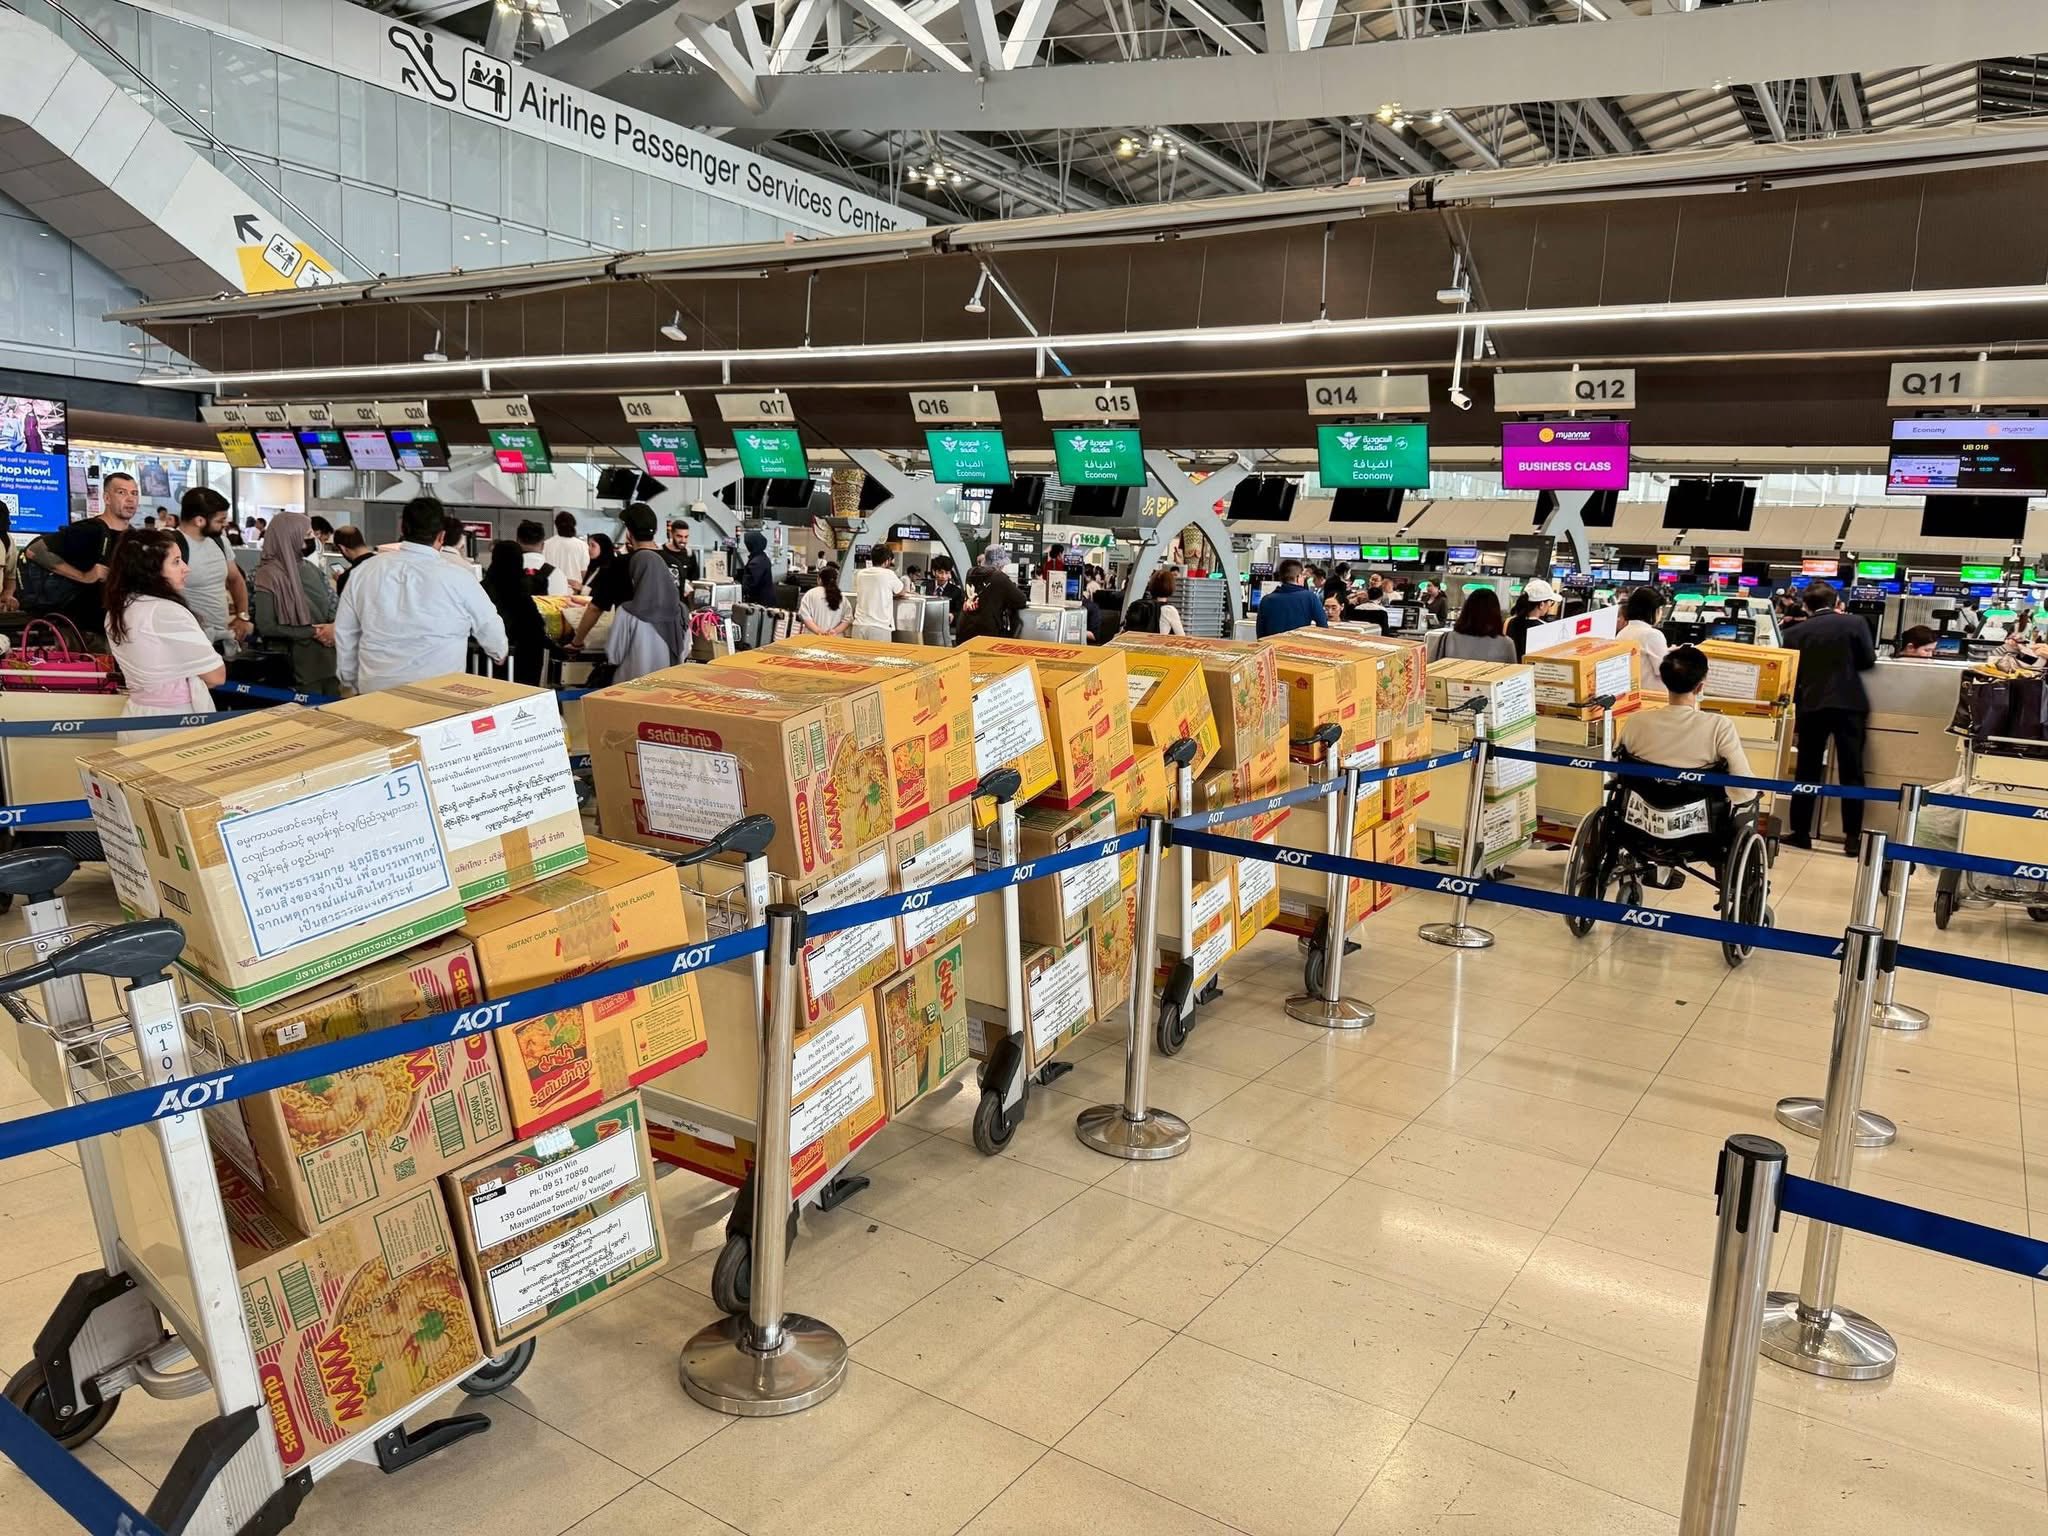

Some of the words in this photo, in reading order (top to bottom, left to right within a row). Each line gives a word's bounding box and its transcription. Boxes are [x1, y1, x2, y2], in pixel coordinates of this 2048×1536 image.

[520, 82, 605, 140] Airline
[616, 115, 739, 185] Passenger
[747, 163, 832, 218] Services
[839, 197, 896, 233] Center
[1575, 380, 1625, 401] Q12
[1903, 372, 1961, 395] Q11
[1095, 396, 1129, 412] Q15
[1315, 388, 1357, 405] Q14
[358, 409, 375, 419] Q21
[405, 408, 424, 419] Q20
[506, 404, 528, 417] Q19
[627, 403, 651, 416] Q18
[760, 401, 785, 414] Q17
[918, 400, 948, 414] Q16
[224, 412, 239, 421] Q24
[265, 412, 281, 421] Q23
[309, 411, 325, 420] Q22
[1556, 431, 1591, 440] myanmar
[24, 467, 50, 476] Now!
[761, 465, 786, 473] Economy
[1518, 461, 1571, 471] BUSINESS
[1575, 462, 1611, 471] CLASS
[956, 470, 985, 479] Economy
[1085, 470, 1117, 480] Economy
[1353, 471, 1393, 481] Economy
[237, 684, 250, 693] AOT
[294, 693, 309, 703] AOT
[51, 720, 84, 733] AOT
[180, 715, 208, 725] AOT
[714, 759, 729, 774] 53
[1427, 758, 1438, 768] AOT
[1569, 759, 1597, 768] AOT
[1387, 767, 1398, 776] AOT
[1677, 772, 1705, 782] AOT
[383, 776, 411, 801] 15
[1320, 782, 1332, 793] AOT
[1792, 783, 1822, 794] AOT
[1268, 797, 1282, 809] AOT
[824, 777, 843, 849] MAMA
[1207, 811, 1224, 823] AOT
[1101, 838, 1120, 855] AOT
[1275, 850, 1312, 865] AOT
[257, 864, 344, 899] วัดพระธรรมกาย
[349, 836, 424, 872] มูลนิธิธรรมกาย
[1012, 864, 1036, 882] AOT
[255, 872, 352, 916] มอบสิ่งของจำเป็น
[357, 844, 437, 882] เพื่อบรรเทาทุกข์
[1436, 877, 1480, 895] AOT
[258, 859, 442, 931] จากเหตุการณ์แผ่นดินไหวในเมียนมา
[901, 891, 932, 911] AOT
[507, 937, 533, 950] INSTANT
[534, 930, 548, 942] CUP
[615, 901, 629, 912] YUM
[629, 890, 655, 906] FLAVOUR
[1621, 909, 1671, 928] AOT
[671, 944, 716, 973] AOT
[450, 1002, 511, 1036] AOT
[146, 1021, 174, 1036] VTBS
[283, 1025, 298, 1037] LF
[530, 1058, 593, 1107] รสต้มยำกุ้ง
[152, 1075, 234, 1118] AOT
[470, 1095, 483, 1126] MMSG
[482, 1096, 498, 1132] 412015
[537, 1173, 544, 1181] U
[545, 1164, 563, 1179] Nyan
[563, 1159, 578, 1171] Win
[529, 1188, 542, 1199] Ph:
[543, 1182, 553, 1192] 09
[554, 1176, 563, 1186] 51
[566, 1165, 590, 1183] 70850
[475, 1191, 499, 1204] Yangon
[500, 1209, 515, 1224] 139
[516, 1195, 555, 1217] Gandamar
[555, 1180, 581, 1200] Street/
[581, 1178, 587, 1186] 8
[588, 1164, 617, 1184] Quarter/
[509, 1209, 552, 1232] Mayangone
[552, 1190, 587, 1214] Township/
[589, 1178, 613, 1197] Yangon
[261, 1295, 276, 1328] MMSG
[317, 1327, 363, 1422] MAMA
[264, 1375, 299, 1453] รสต้มยำกุ้ง
